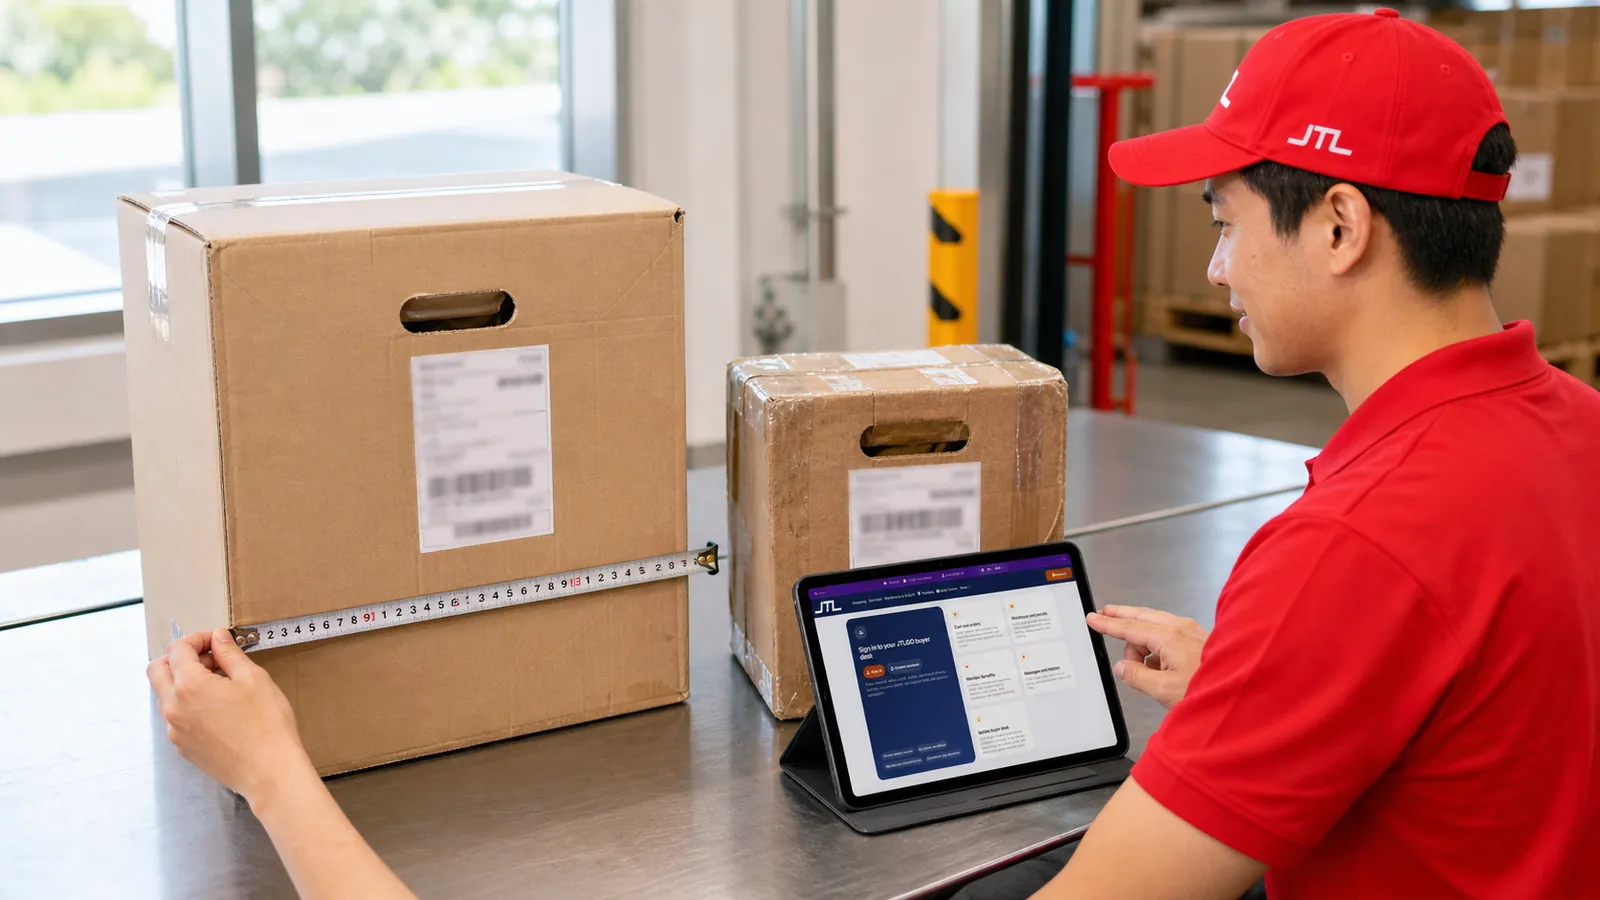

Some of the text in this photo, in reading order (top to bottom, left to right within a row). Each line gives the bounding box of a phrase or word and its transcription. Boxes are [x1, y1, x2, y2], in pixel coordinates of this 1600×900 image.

[1287, 124, 1353, 156] JTL
[267, 630, 275, 639] 2
[281, 627, 288, 637] 3
[294, 625, 301, 634] 4
[309, 623, 316, 632] 5
[323, 620, 330, 629] 6
[337, 618, 343, 627] 7
[351, 615, 358, 624] 8
[382, 610, 387, 619] 1
[396, 608, 402, 617] 2
[410, 605, 417, 614] 3
[424, 603, 431, 611] 4
[438, 600, 445, 609] 5
[478, 593, 485, 602] 3
[492, 591, 499, 600] 4
[521, 586, 527, 595] 6
[534, 584, 540, 593] 7
[548, 582, 555, 590] 8
[561, 580, 568, 588] 9
[598, 573, 604, 582] 2
[611, 571, 618, 580] 3
[625, 568, 631, 577] 4
[814, 600, 842, 614] JTL
